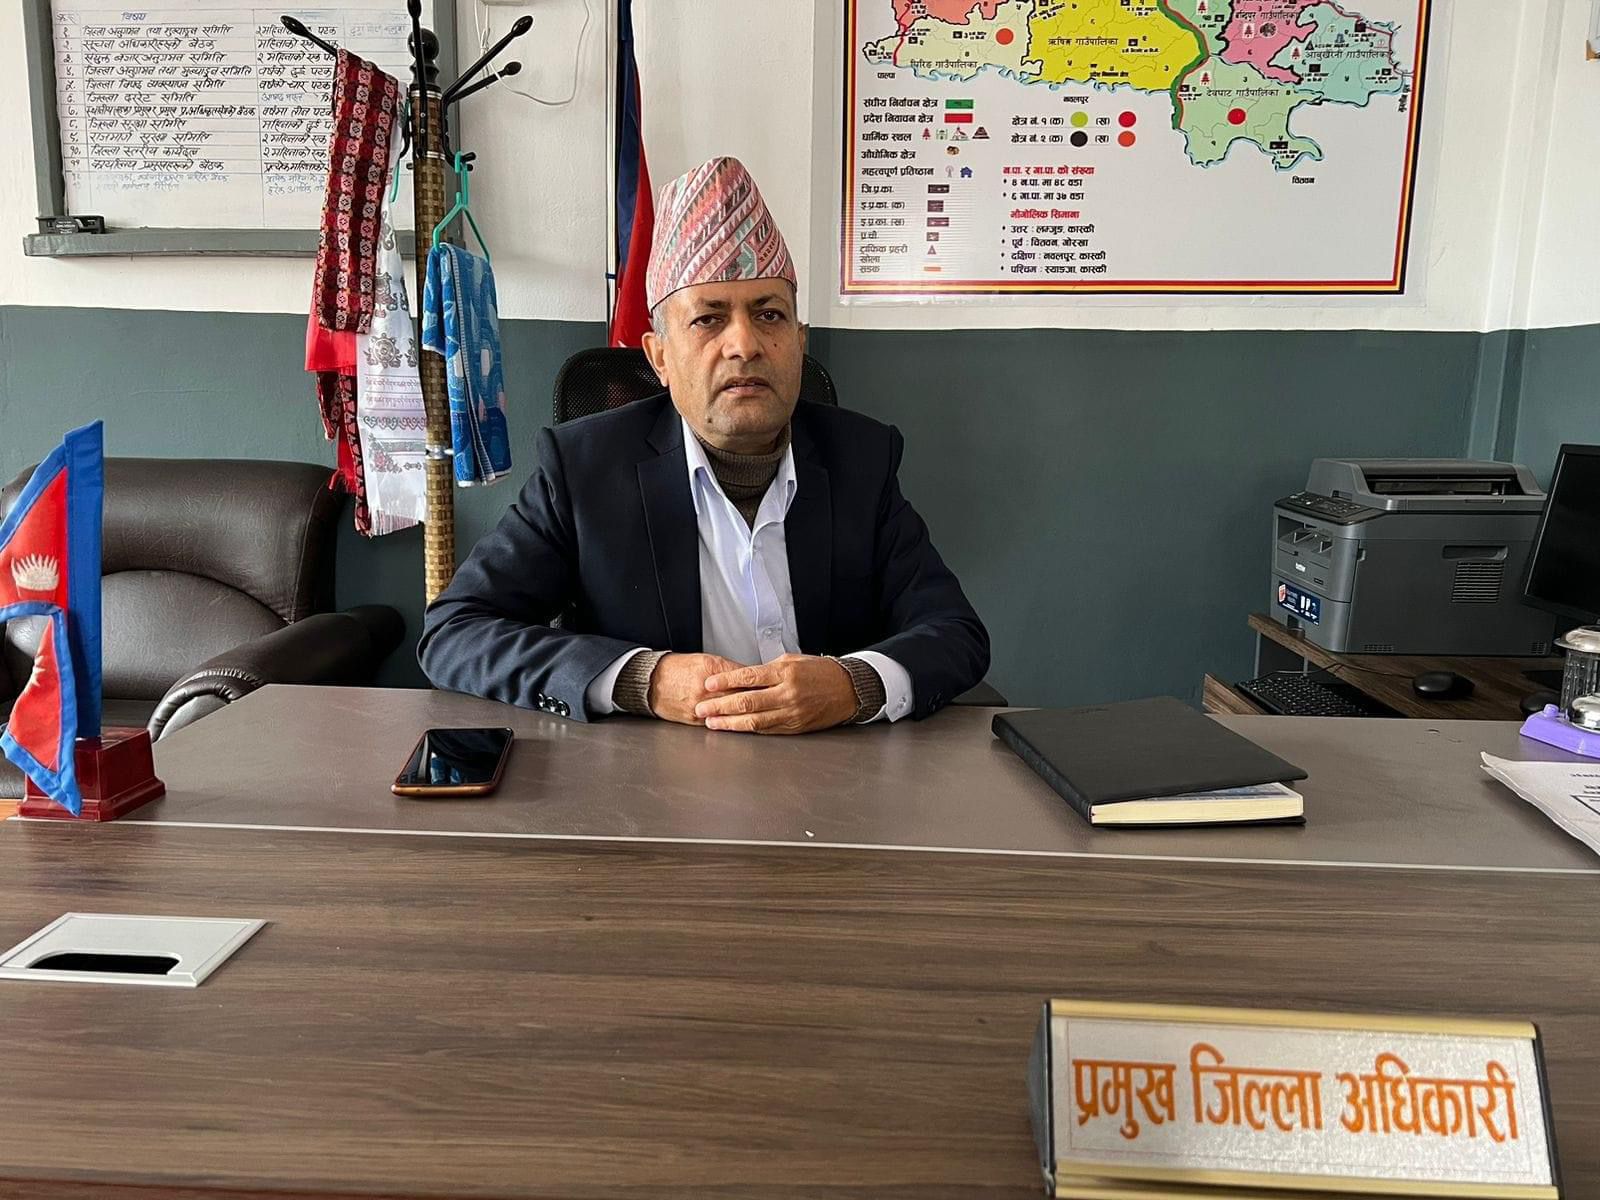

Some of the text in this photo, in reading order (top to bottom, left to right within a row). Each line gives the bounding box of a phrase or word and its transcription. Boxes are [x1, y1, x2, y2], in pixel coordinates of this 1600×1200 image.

[1076, 36, 1118, 46] गाउँपालिका
[935, 59, 977, 68] गाउँपालिका
[1236, 88, 1279, 97] गाउँपालिका
[922, 97, 938, 108] क्षेत्र
[918, 113, 934, 123] क्षेत्र
[1012, 115, 1028, 126] क्षेत्र
[1049, 117, 1064, 126] (क)
[1011, 133, 1027, 143] क्षेत्र
[1049, 134, 1063, 143] (क)
[900, 149, 916, 159] क्षेत्र
[1067, 223, 1095, 233] कास्की
[1079, 250, 1106, 260] कास्की
[1079, 263, 1107, 274] कास्की
[1072, 1042, 1519, 1143] प्रमुख जिल्ला अधिकारी
